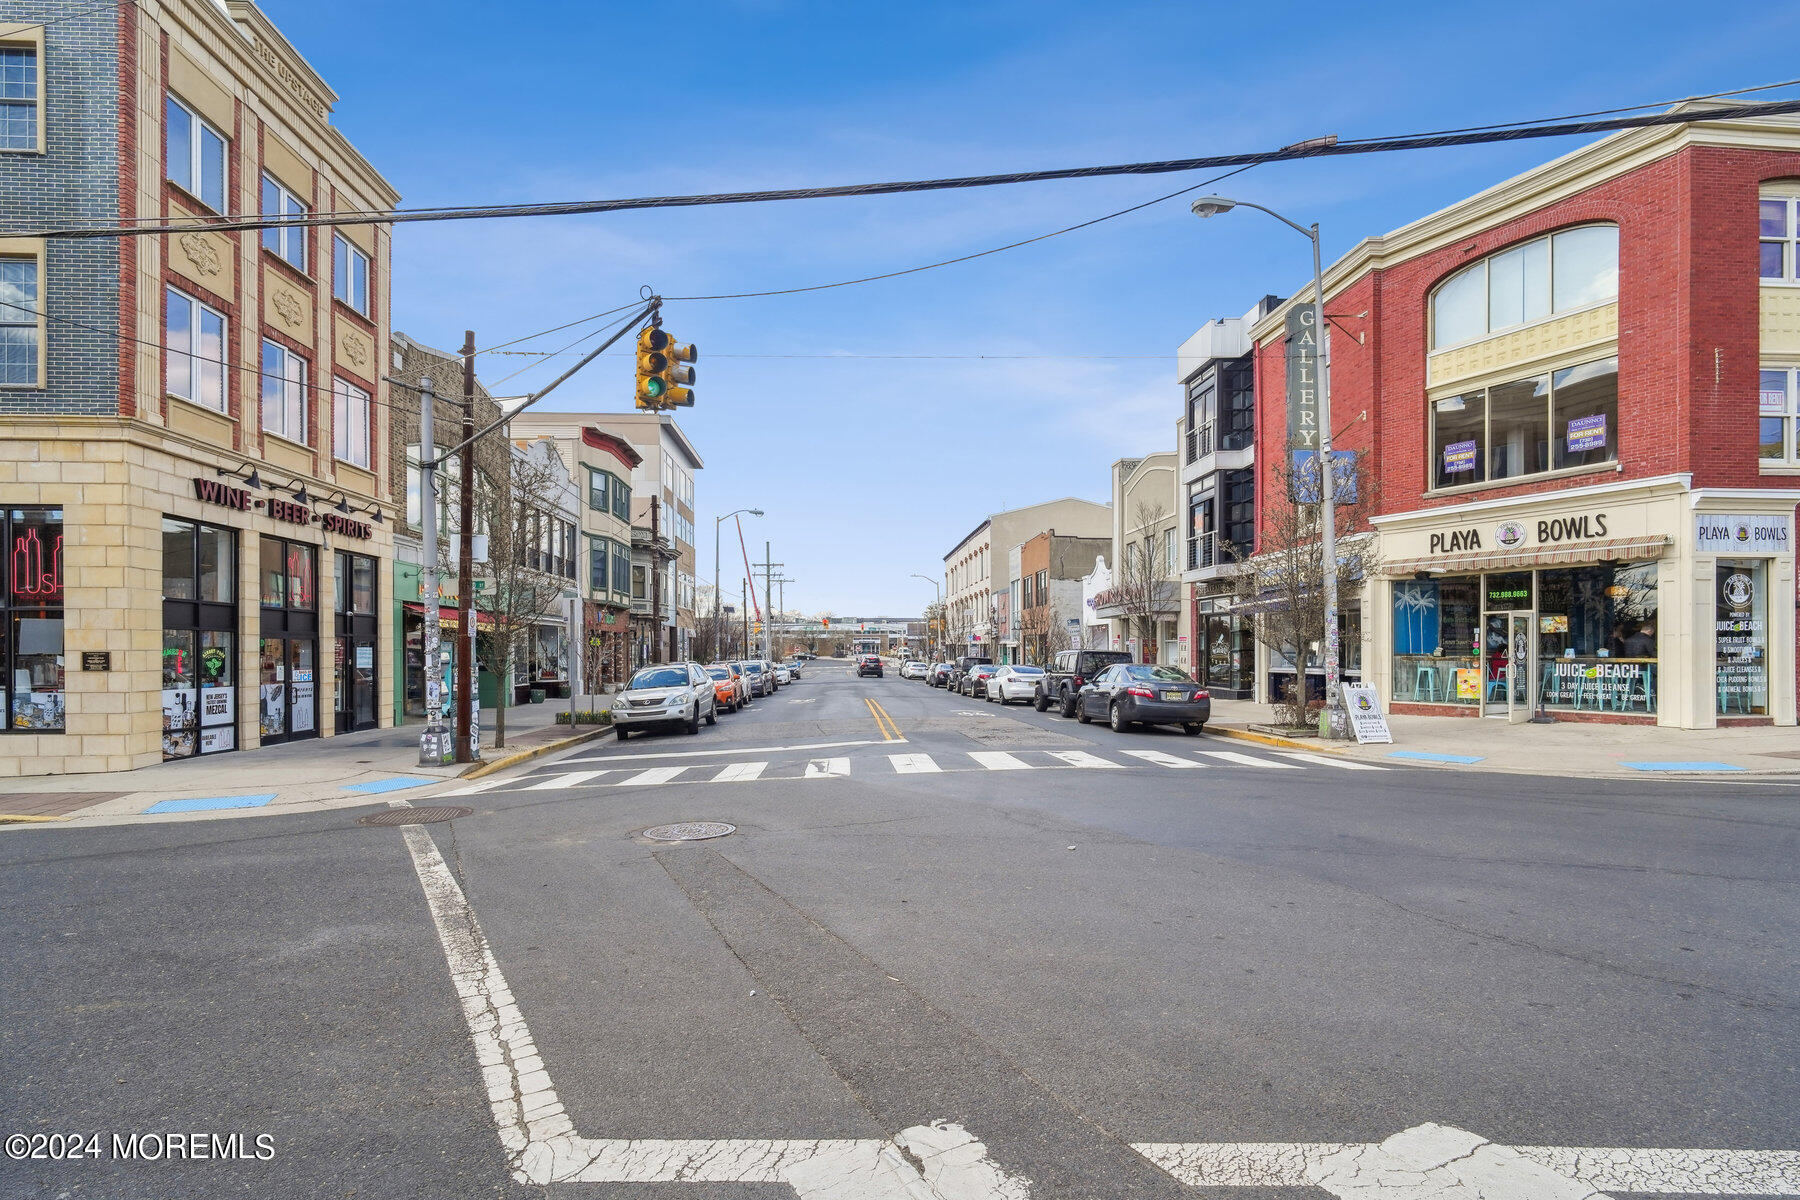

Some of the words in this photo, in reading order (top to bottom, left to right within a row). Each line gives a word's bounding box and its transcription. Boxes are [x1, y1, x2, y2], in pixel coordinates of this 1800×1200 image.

[253, 36, 275, 68] THE
[277, 63, 323, 118] UPSTAGE
[1298, 311, 1317, 446] GALLERY
[1585, 428, 1602, 436] RENT
[193, 478, 251, 511] WINE
[268, 498, 310, 525] BEER
[323, 512, 373, 540] SPIRITS
[1430, 529, 1481, 553] PLAYA
[1537, 514, 1607, 543] BOWLS
[1699, 526, 1730, 540] PLAYA
[1754, 526, 1787, 541] BOWLS
[1715, 621, 1735, 631] JUICE
[1740, 621, 1762, 631] BEACH
[1554, 663, 1586, 677] JUICE
[1597, 664, 1639, 678] BEACH
[1561, 682, 1566, 690] 3
[1567, 682, 1579, 690] DAY
[1601, 683, 1630, 692] CLEANSE
[206, 704, 228, 716] MEZCAL
